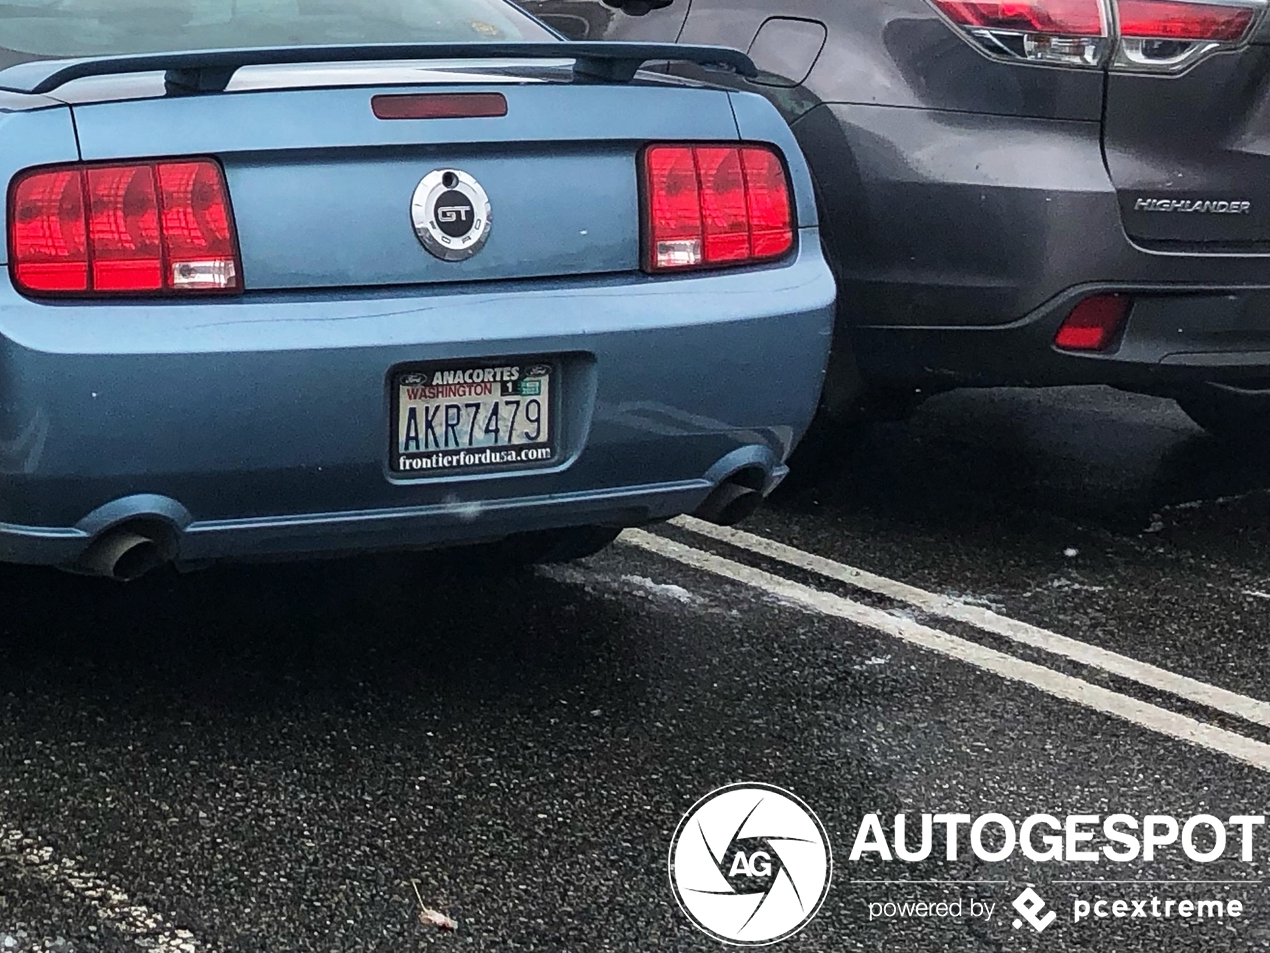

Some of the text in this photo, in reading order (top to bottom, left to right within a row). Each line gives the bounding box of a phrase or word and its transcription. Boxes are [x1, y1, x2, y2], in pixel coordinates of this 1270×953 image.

[437, 206, 470, 222] GT
[1134, 198, 1251, 214] HIGHLANDER
[429, 218, 482, 245] FORD
[432, 367, 520, 385] ANACORTES
[406, 382, 493, 401] WASHINGTON
[506, 382, 513, 393] 1
[404, 399, 541, 451] AKR7479
[399, 447, 551, 470] frontierfordusa.com
